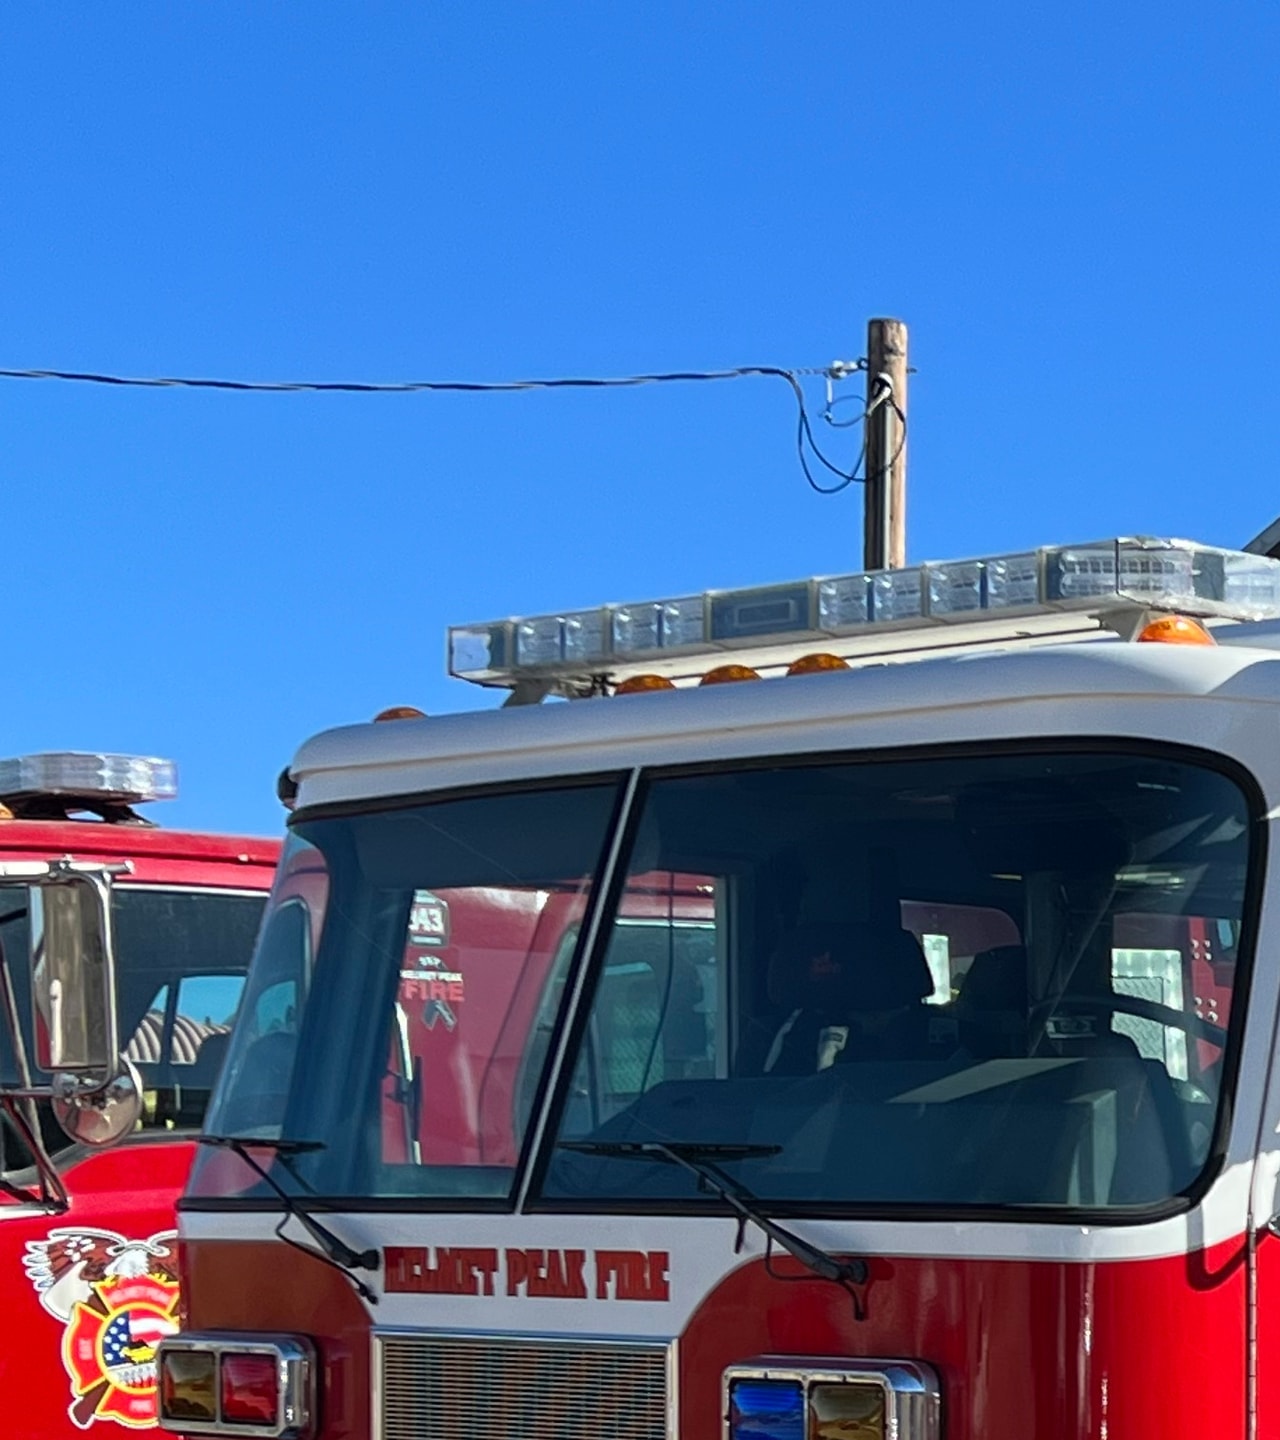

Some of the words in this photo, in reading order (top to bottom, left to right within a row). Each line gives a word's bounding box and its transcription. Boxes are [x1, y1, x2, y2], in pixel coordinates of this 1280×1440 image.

[404, 979, 465, 1002] FIRE
[383, 1246, 499, 1297] HELMET
[504, 1247, 588, 1299] PEAK
[594, 1249, 670, 1302] FIRE
